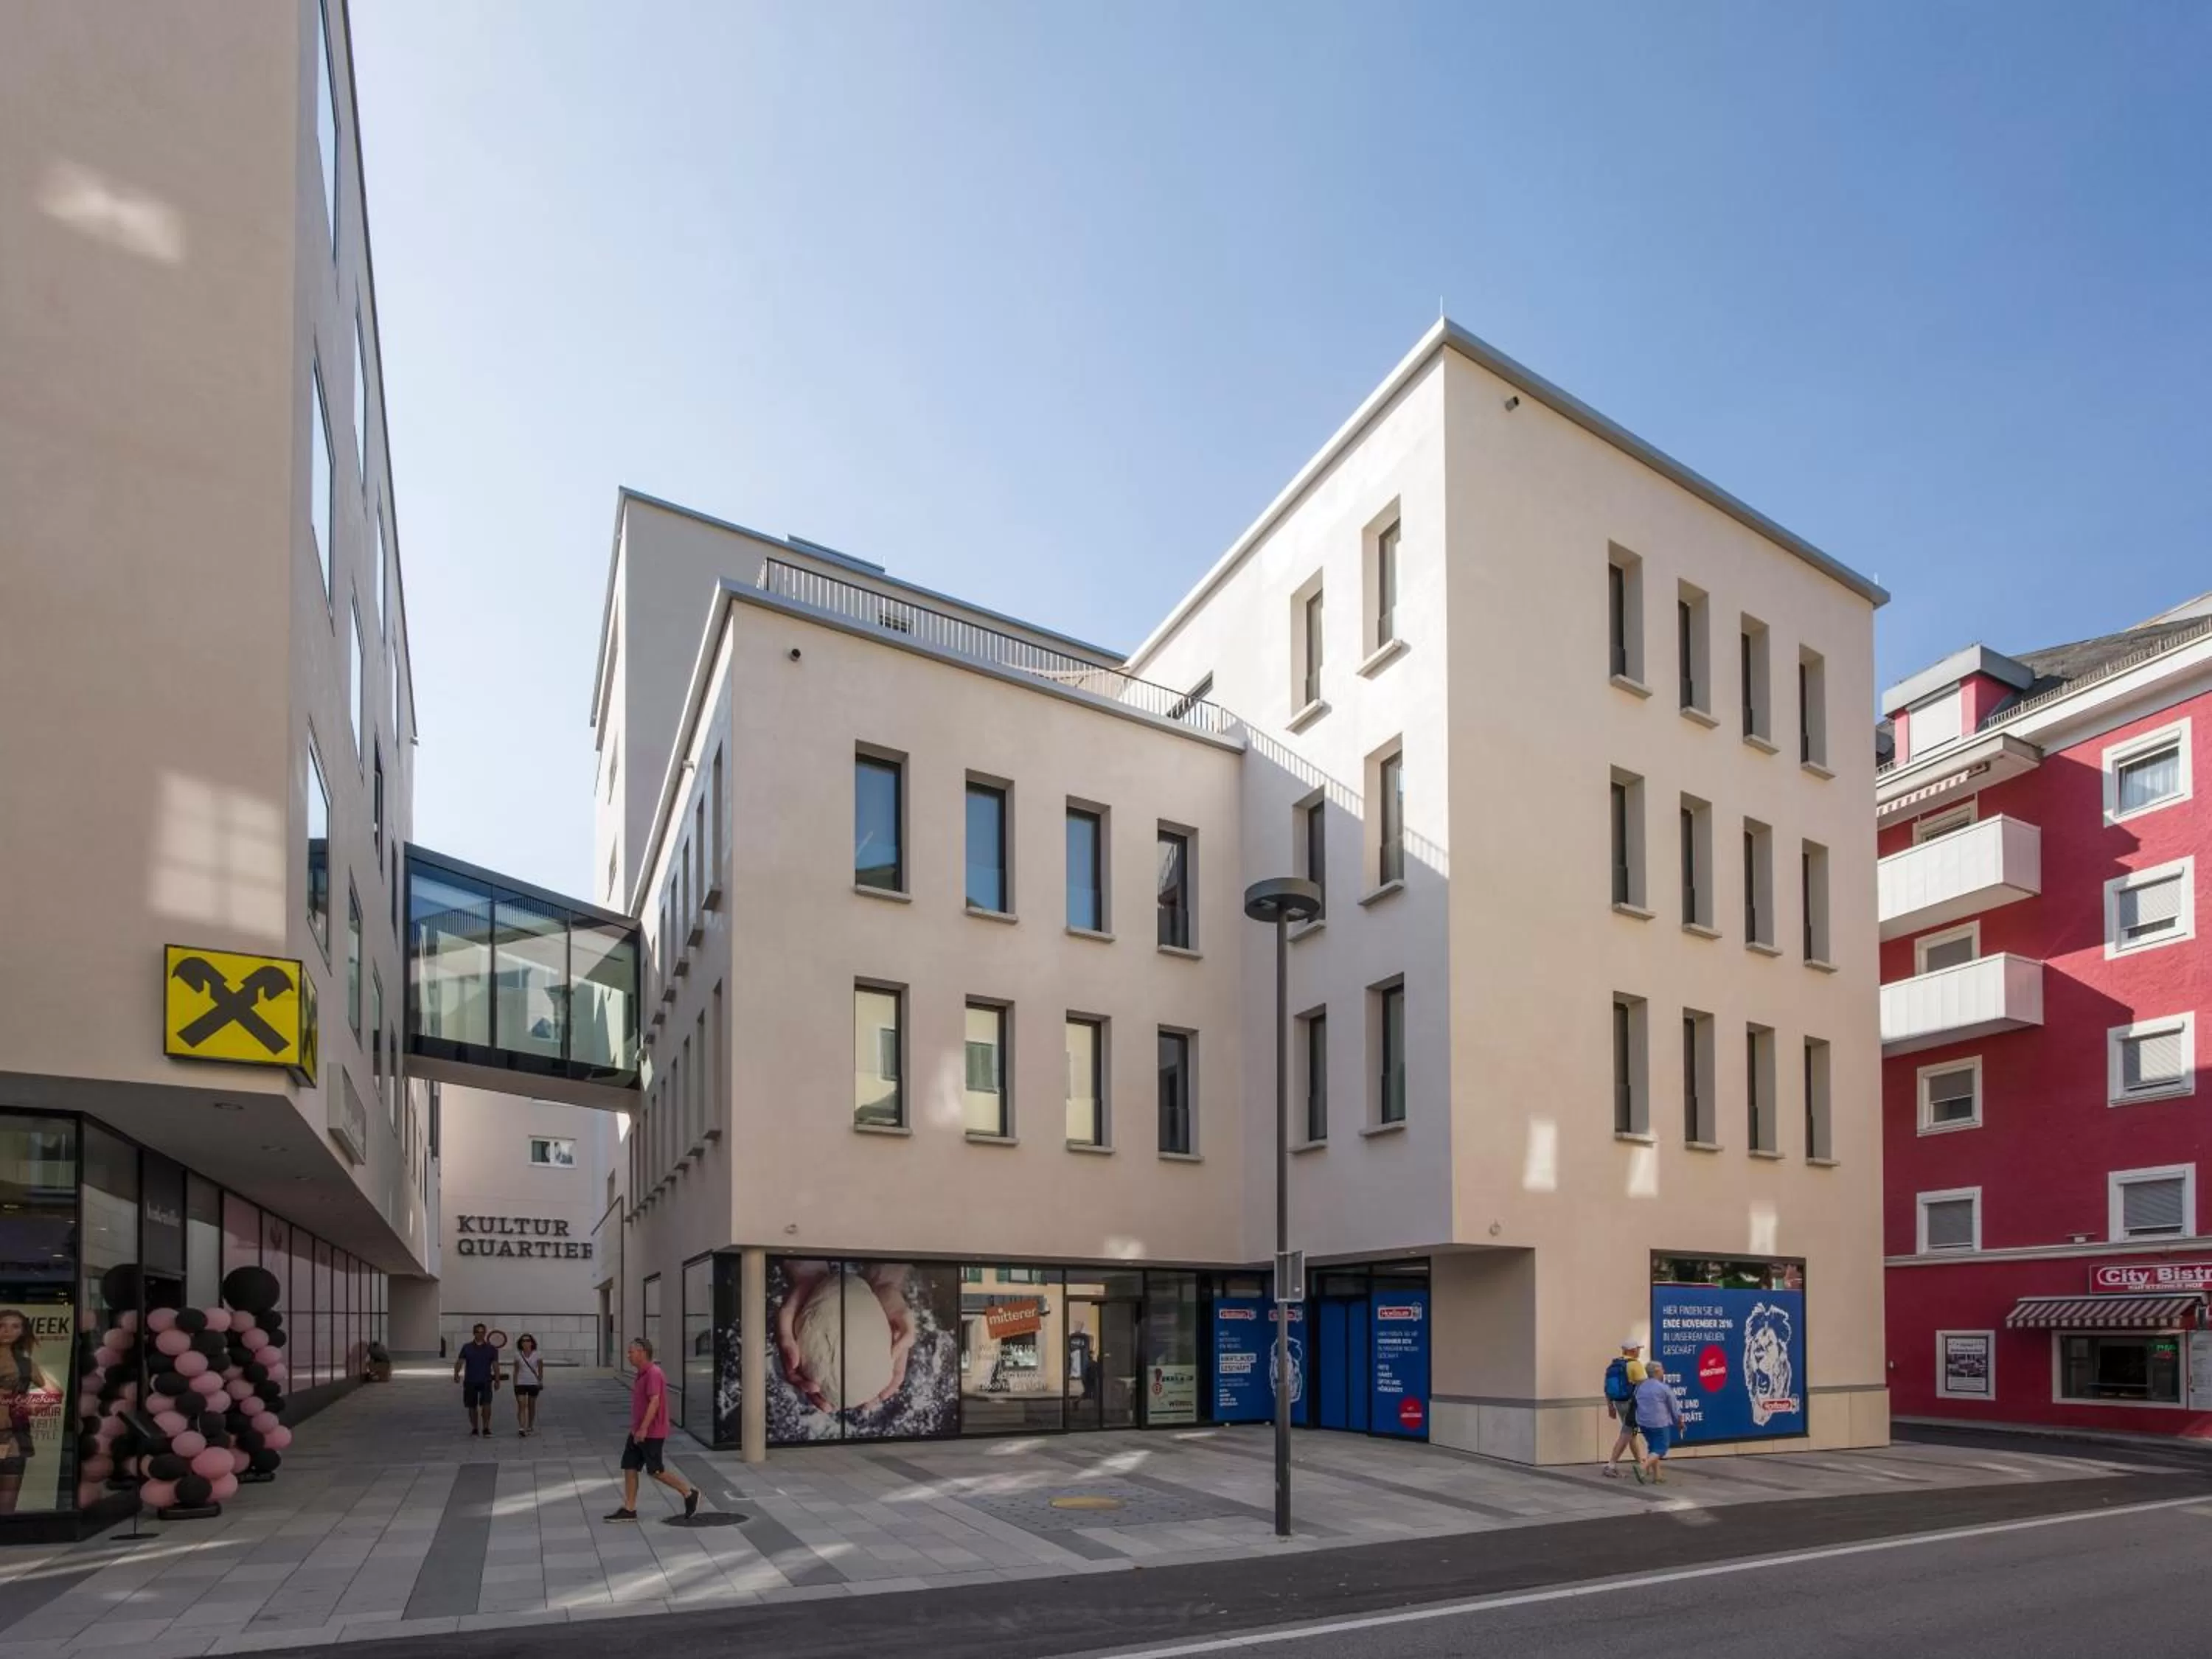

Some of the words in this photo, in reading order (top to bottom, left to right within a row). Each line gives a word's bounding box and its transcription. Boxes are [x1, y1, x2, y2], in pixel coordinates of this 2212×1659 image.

[456, 1214, 570, 1237] KULTUR
[2105, 1269, 2149, 1284] City
[989, 1307, 1035, 1325] mitterer
[1663, 1305, 1677, 1315] HIER
[1663, 1319, 1680, 1328] ENDE
[1682, 1319, 1717, 1328] NOVEMBER
[1663, 1374, 1681, 1383] FOTO
